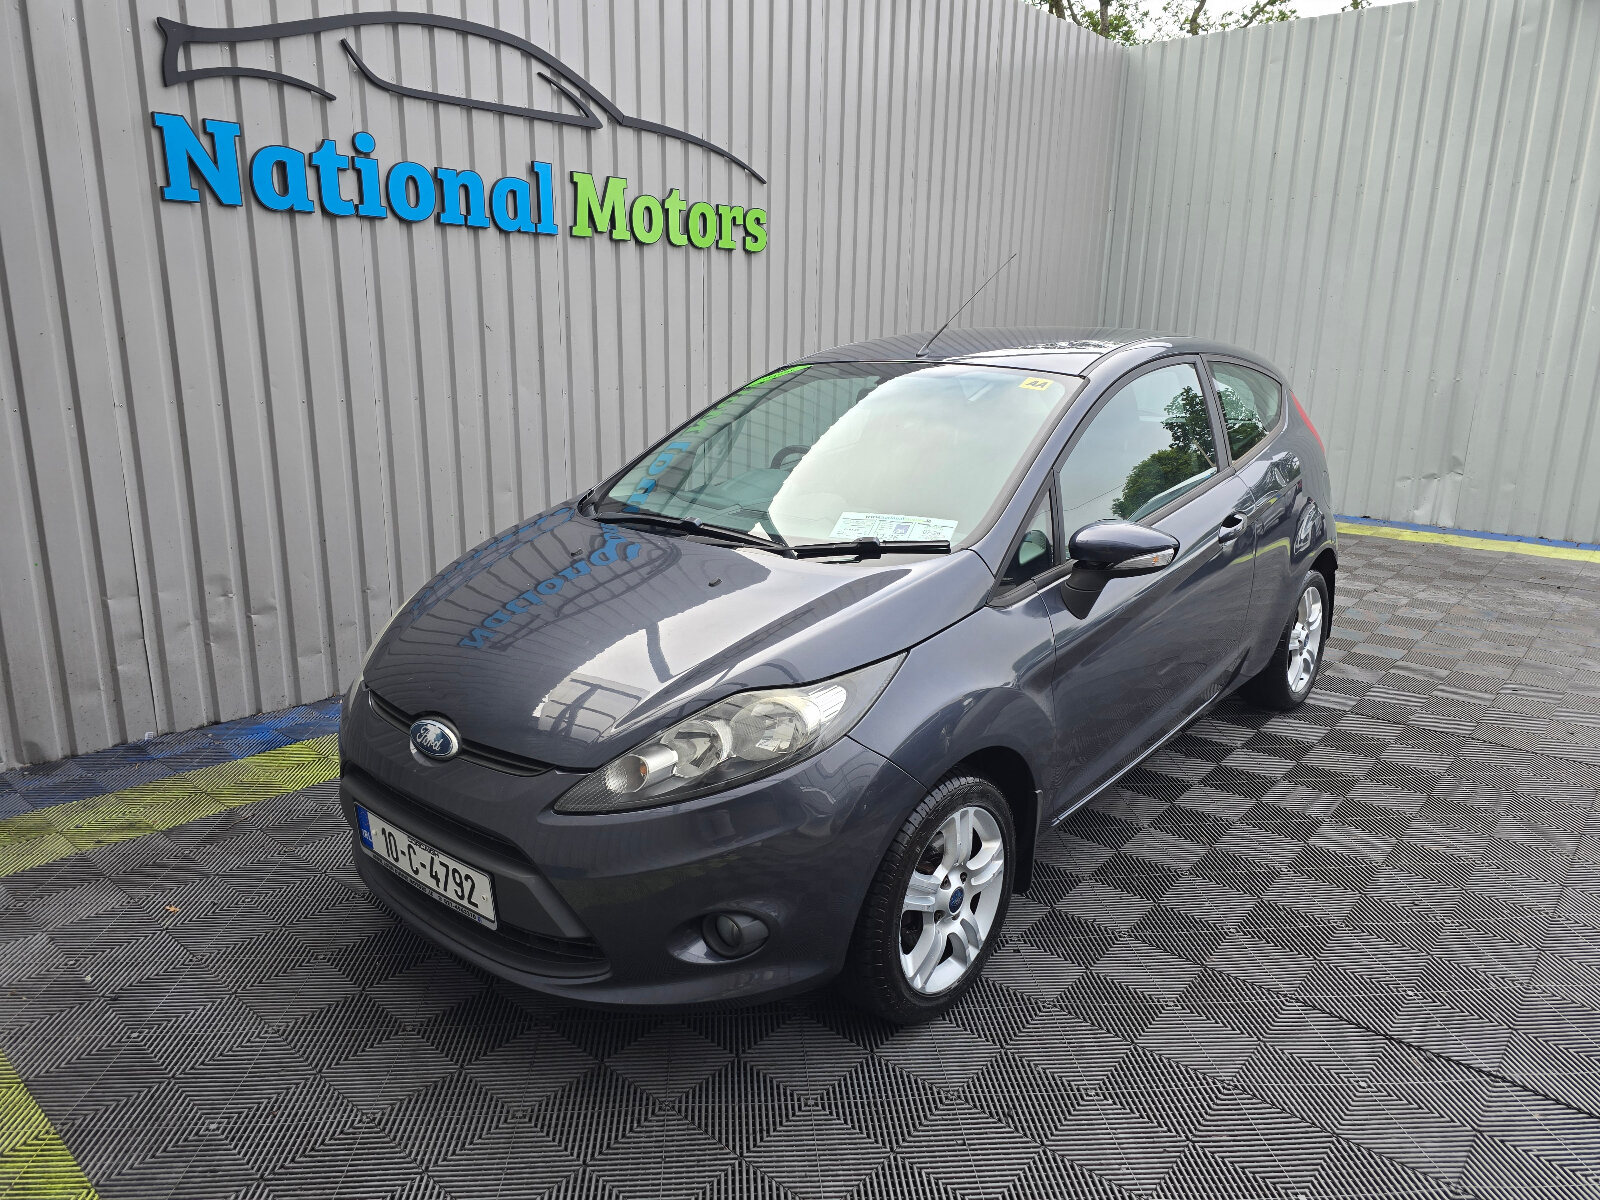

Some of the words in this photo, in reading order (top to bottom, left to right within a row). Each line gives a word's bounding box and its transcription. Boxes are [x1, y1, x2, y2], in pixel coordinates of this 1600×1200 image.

[151, 111, 558, 235] National
[570, 171, 767, 252] Motors
[416, 724, 444, 751] Ford
[381, 827, 478, 909] 10-C-4792
